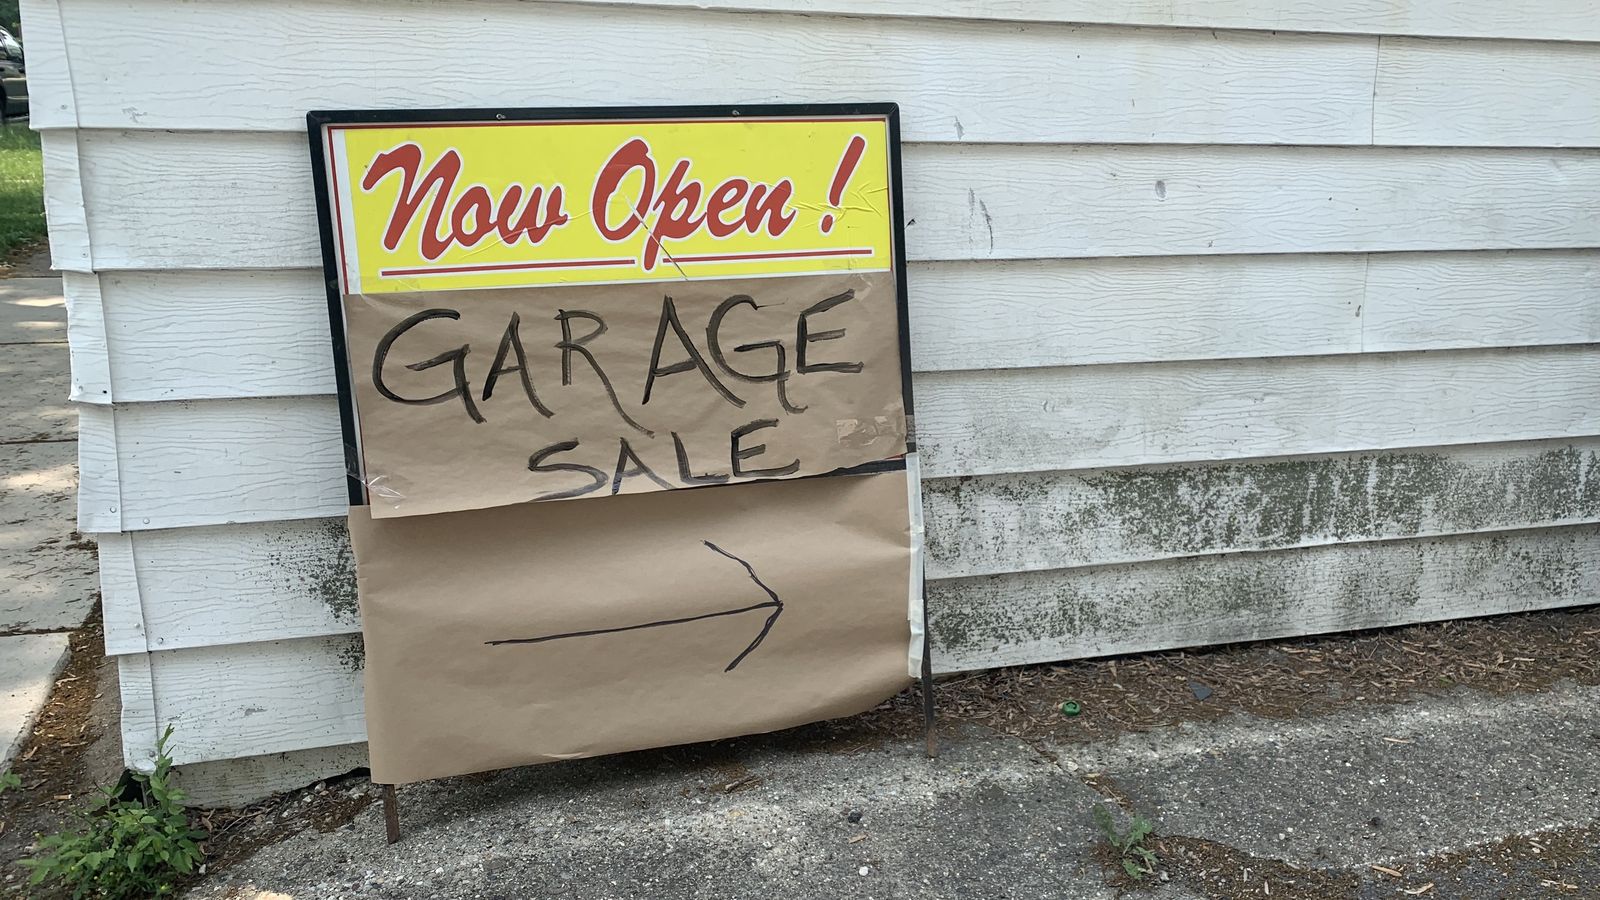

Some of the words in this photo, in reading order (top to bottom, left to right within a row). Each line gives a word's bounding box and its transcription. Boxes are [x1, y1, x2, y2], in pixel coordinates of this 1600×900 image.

[362, 142, 568, 262] Now
[372, 288, 864, 438] GARAGE
[527, 418, 800, 501] SALE
